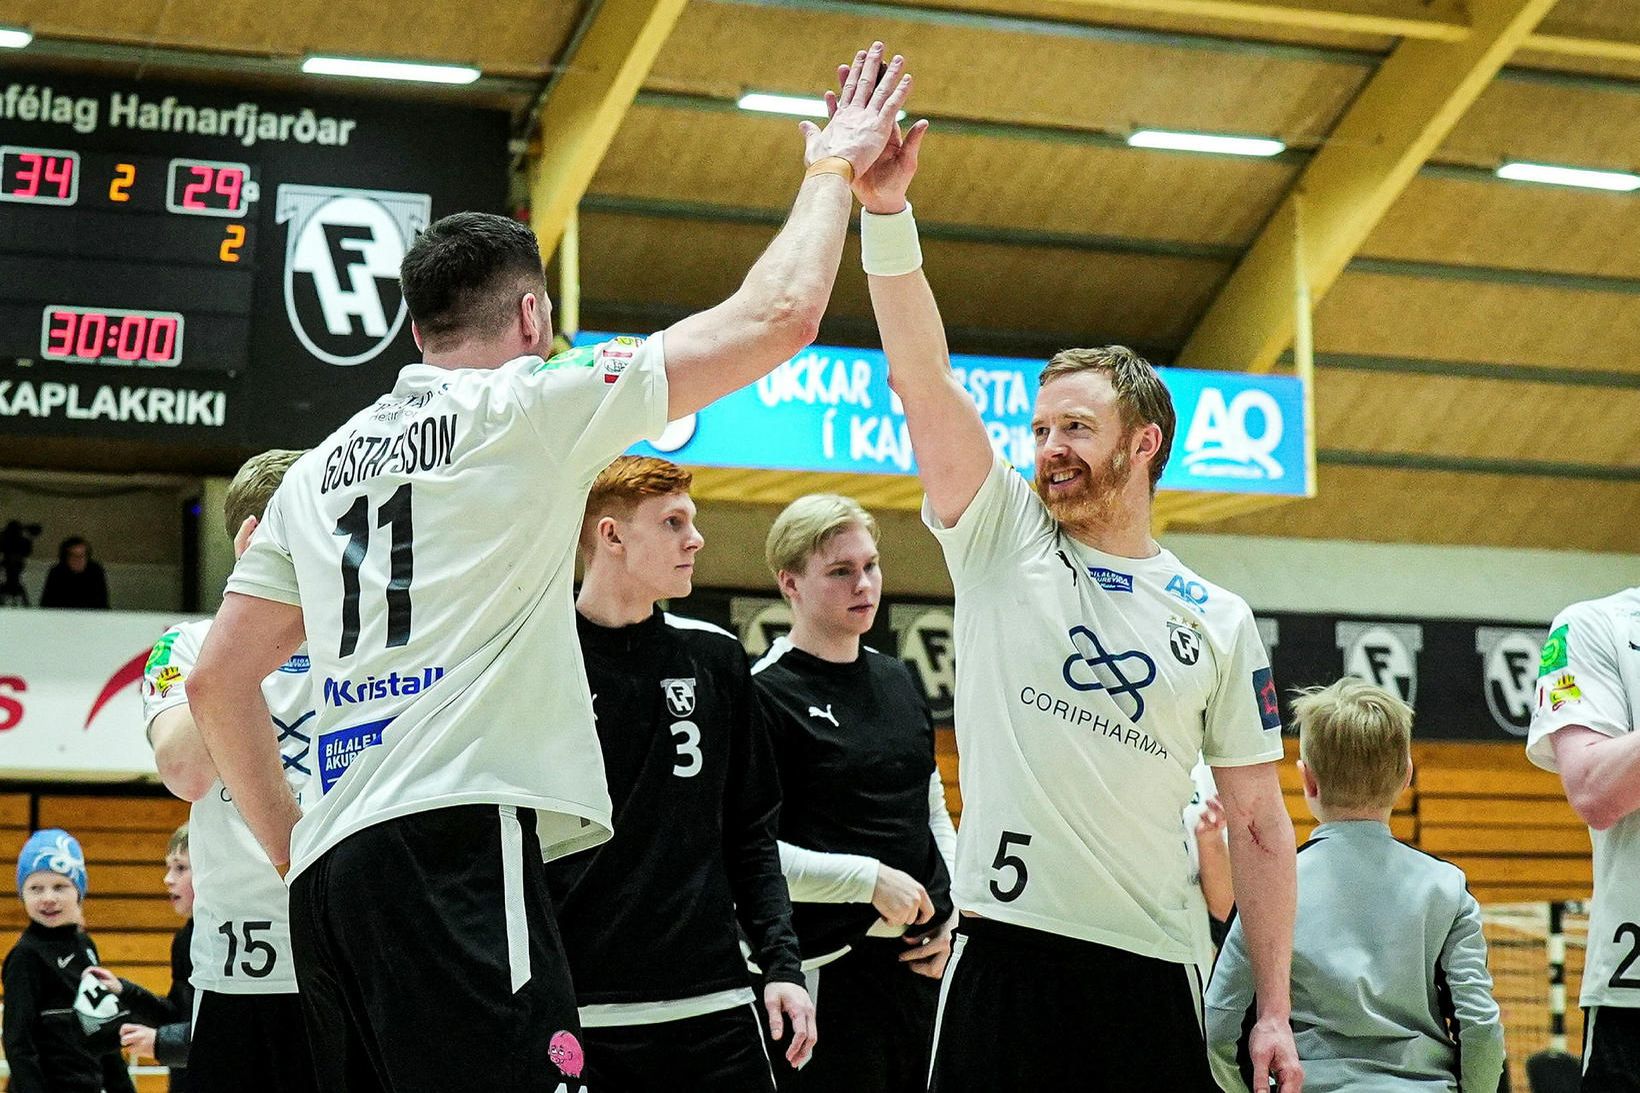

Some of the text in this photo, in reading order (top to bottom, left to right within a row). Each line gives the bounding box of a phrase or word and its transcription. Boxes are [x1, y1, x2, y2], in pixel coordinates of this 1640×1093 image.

[108, 91, 357, 147] Hafnarfjarðar
[13, 153, 244, 211] 34 2 29
[219, 224, 246, 263] 2
[47, 311, 178, 362] 30:00
[320, 413, 457, 496] GÚSTAFSSON
[332, 482, 414, 658] 11
[331, 667, 444, 707] Kristall
[325, 733, 378, 758] BÍLALE
[669, 720, 703, 778] 3
[1020, 686, 1168, 759] CORIPHARMA
[989, 830, 1032, 904] 5
[218, 920, 277, 978] 15
